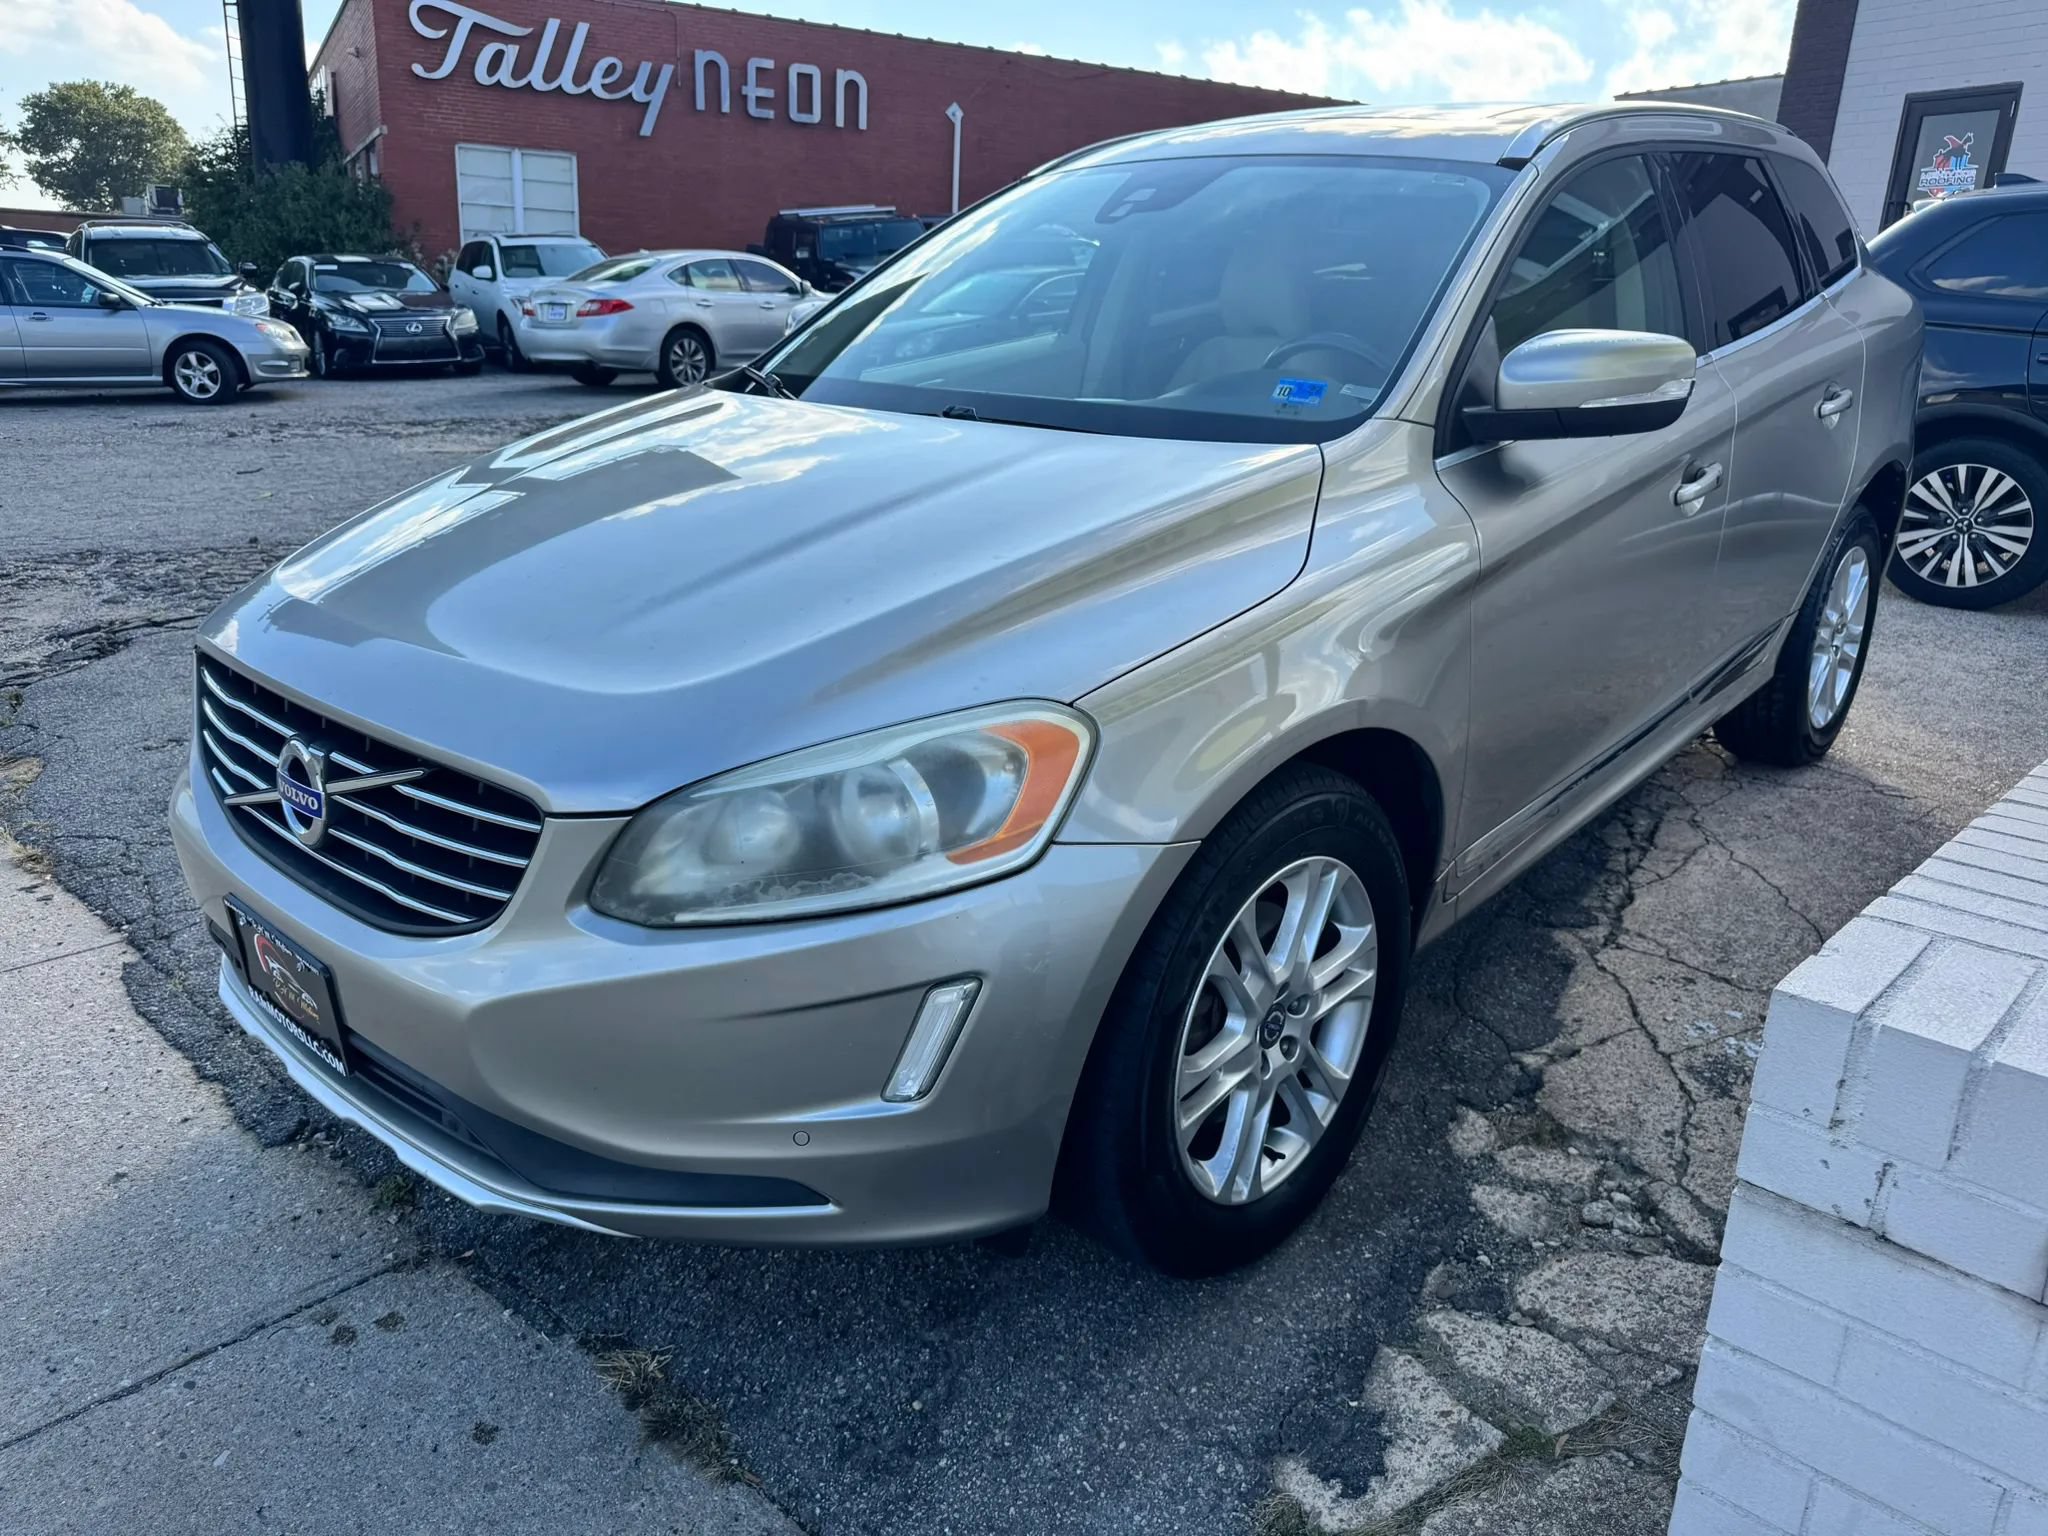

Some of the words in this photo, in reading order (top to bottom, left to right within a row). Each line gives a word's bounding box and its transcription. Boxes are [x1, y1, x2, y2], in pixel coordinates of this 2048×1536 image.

[408, 0, 674, 137] Talley
[694, 48, 868, 131] NEON
[1919, 174, 1976, 187] ROOFING
[1276, 385, 1293, 397] 10
[277, 779, 319, 811] VOLVO
